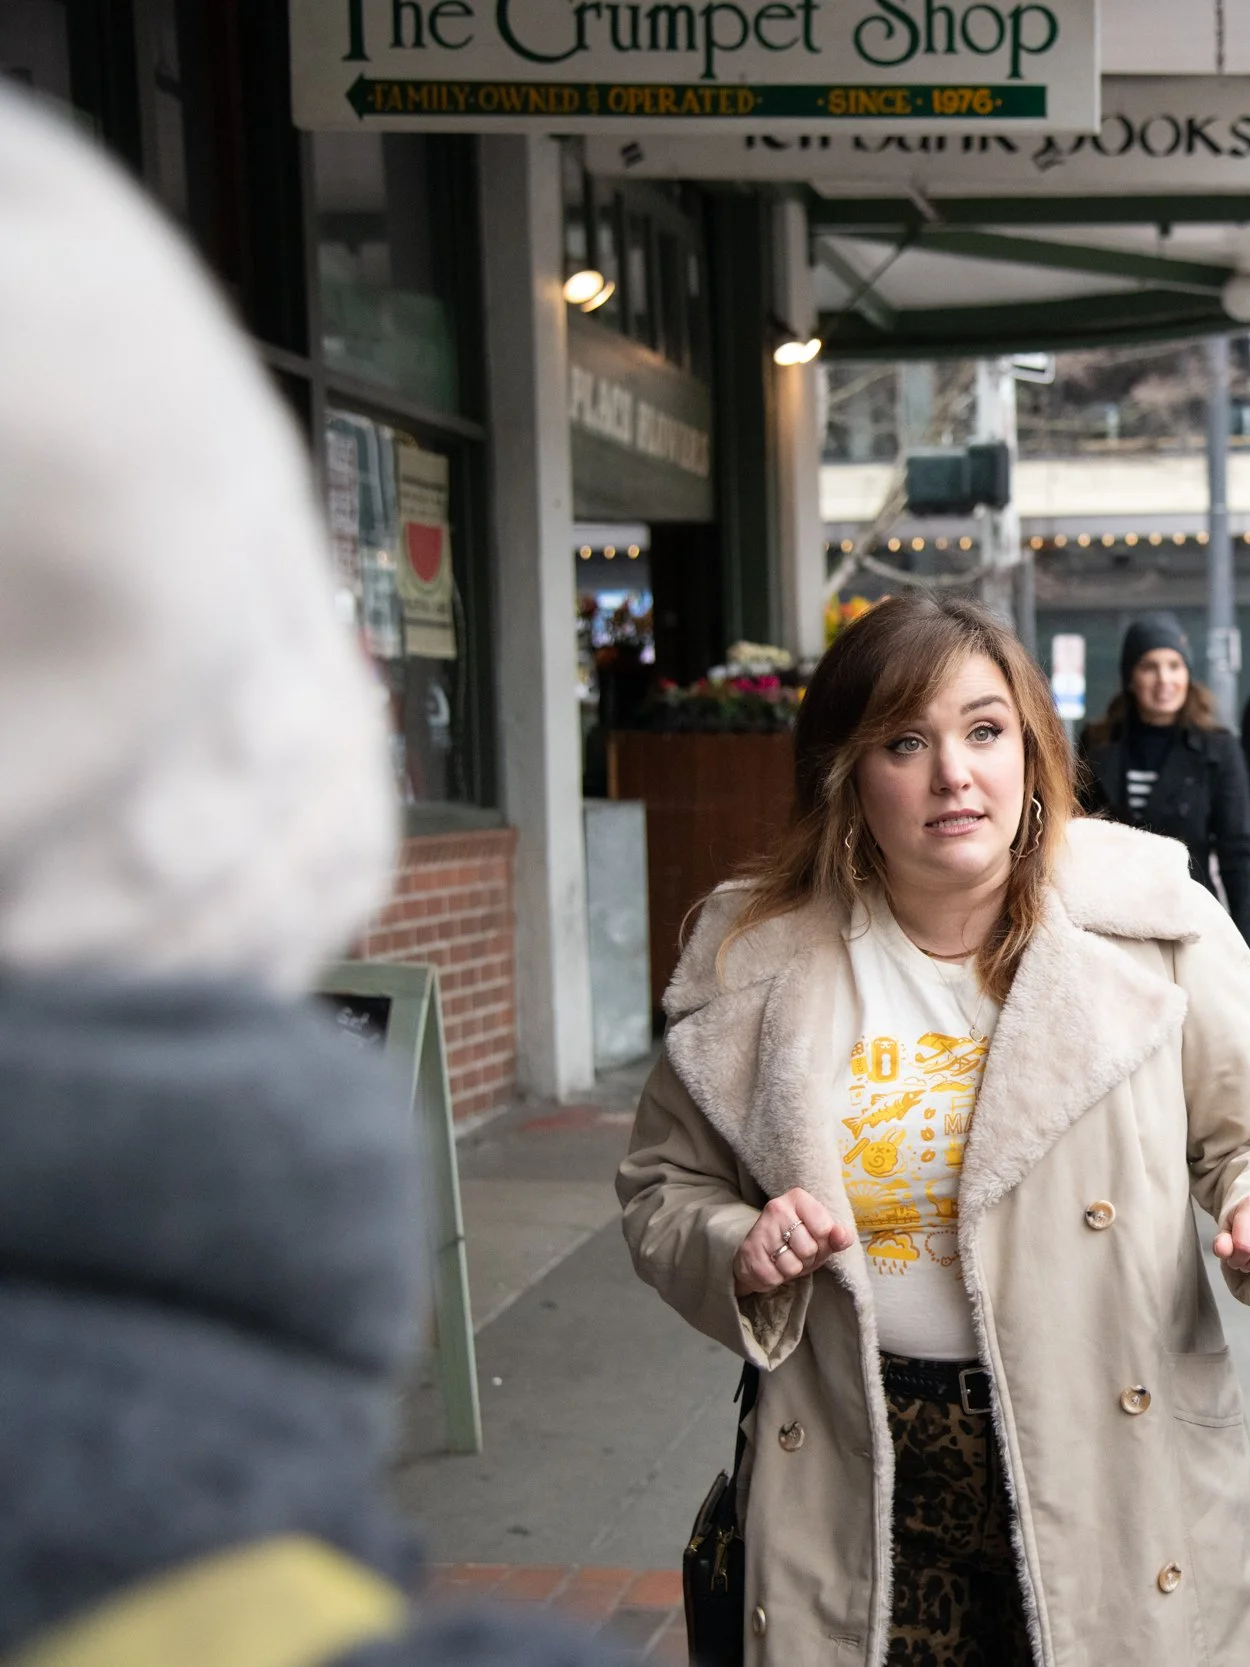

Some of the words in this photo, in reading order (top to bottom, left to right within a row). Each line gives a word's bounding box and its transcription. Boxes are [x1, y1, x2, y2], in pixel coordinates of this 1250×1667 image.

[496, 0, 822, 80] Crumpet
[853, 0, 1059, 80] Shop
[478, 85, 580, 113] OWNED
[607, 86, 755, 115] OPERATED
[828, 88, 912, 115] SINCE
[932, 88, 994, 115] 1976
